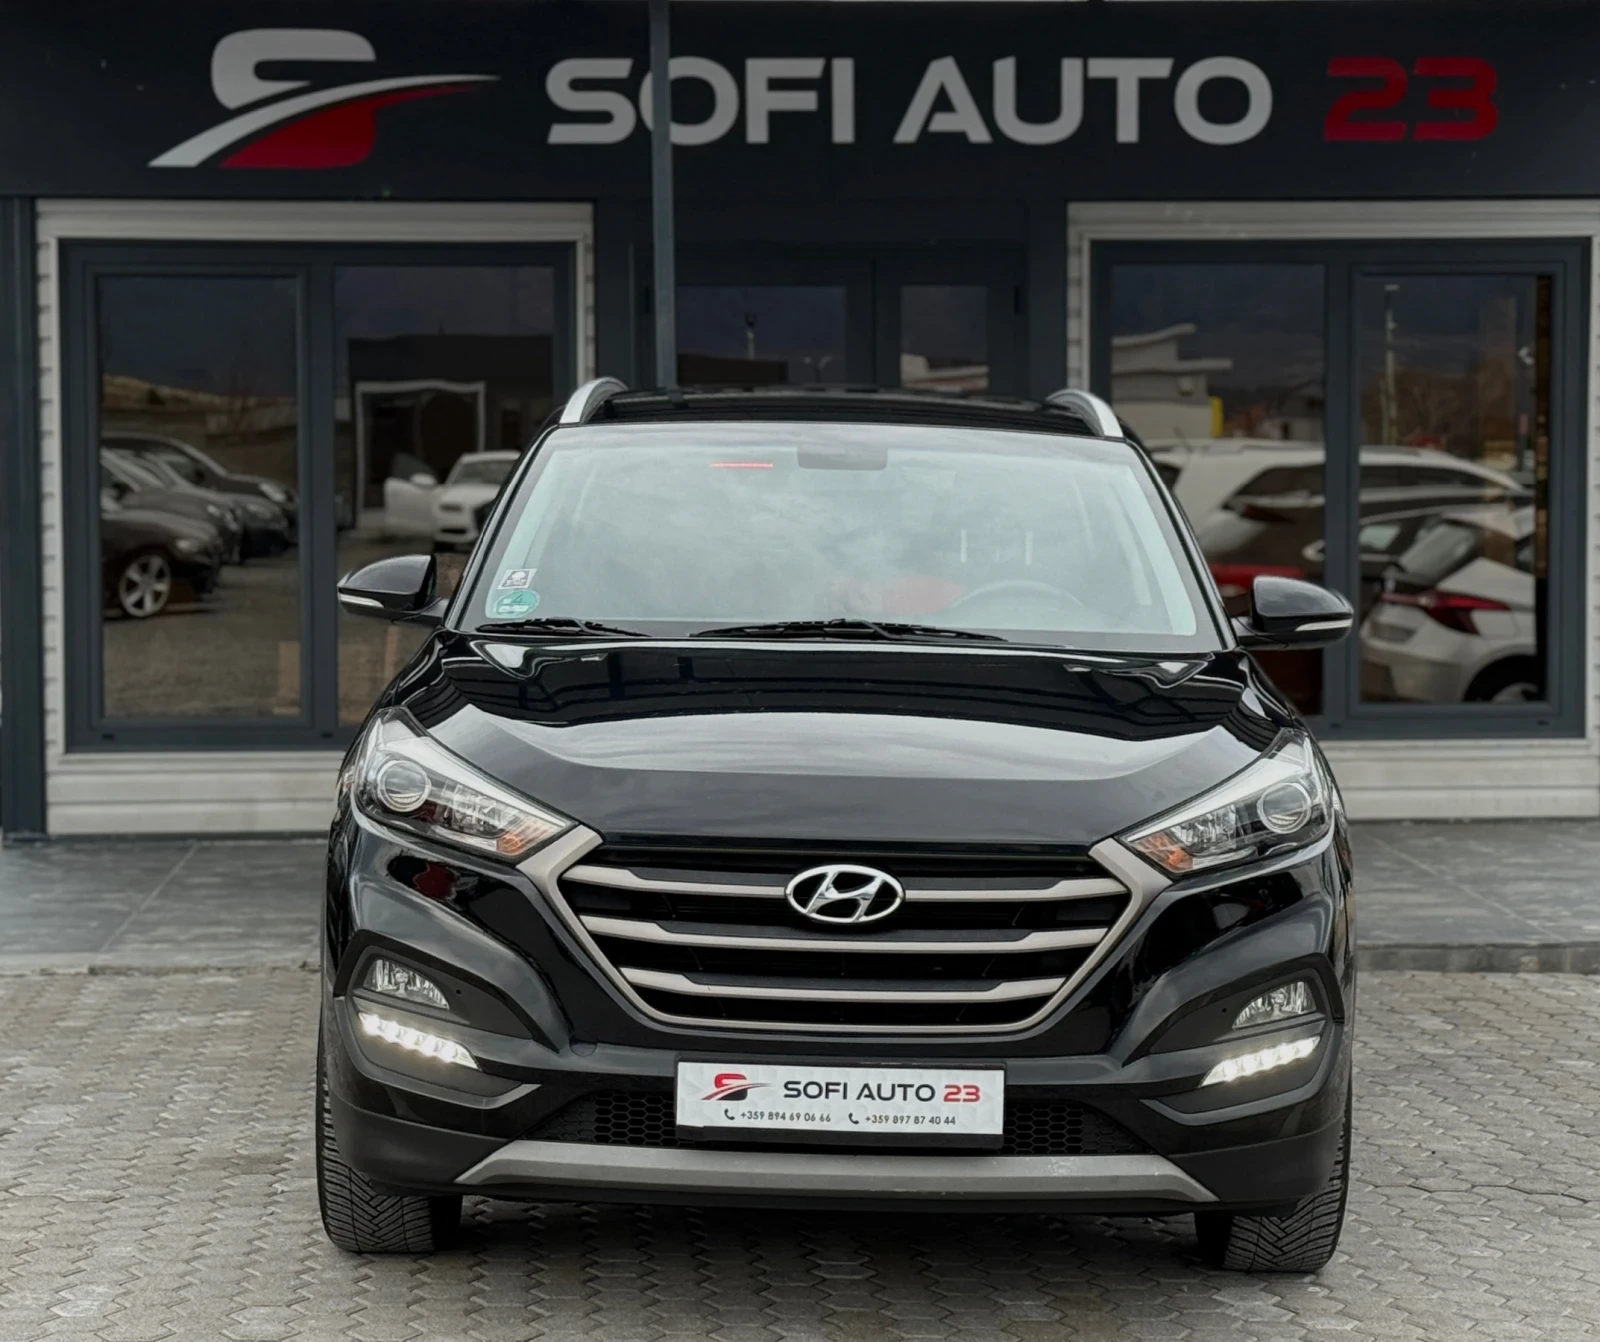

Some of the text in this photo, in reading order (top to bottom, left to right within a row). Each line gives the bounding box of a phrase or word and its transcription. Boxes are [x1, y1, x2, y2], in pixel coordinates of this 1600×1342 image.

[545, 56, 1500, 145] SOFI AUTO 23
[783, 1080, 981, 1103] SOFI AUTO 23
[740, 1110, 831, 1122] +359 894 69 06 66
[865, 1115, 956, 1125] +359 897 87 40 44
